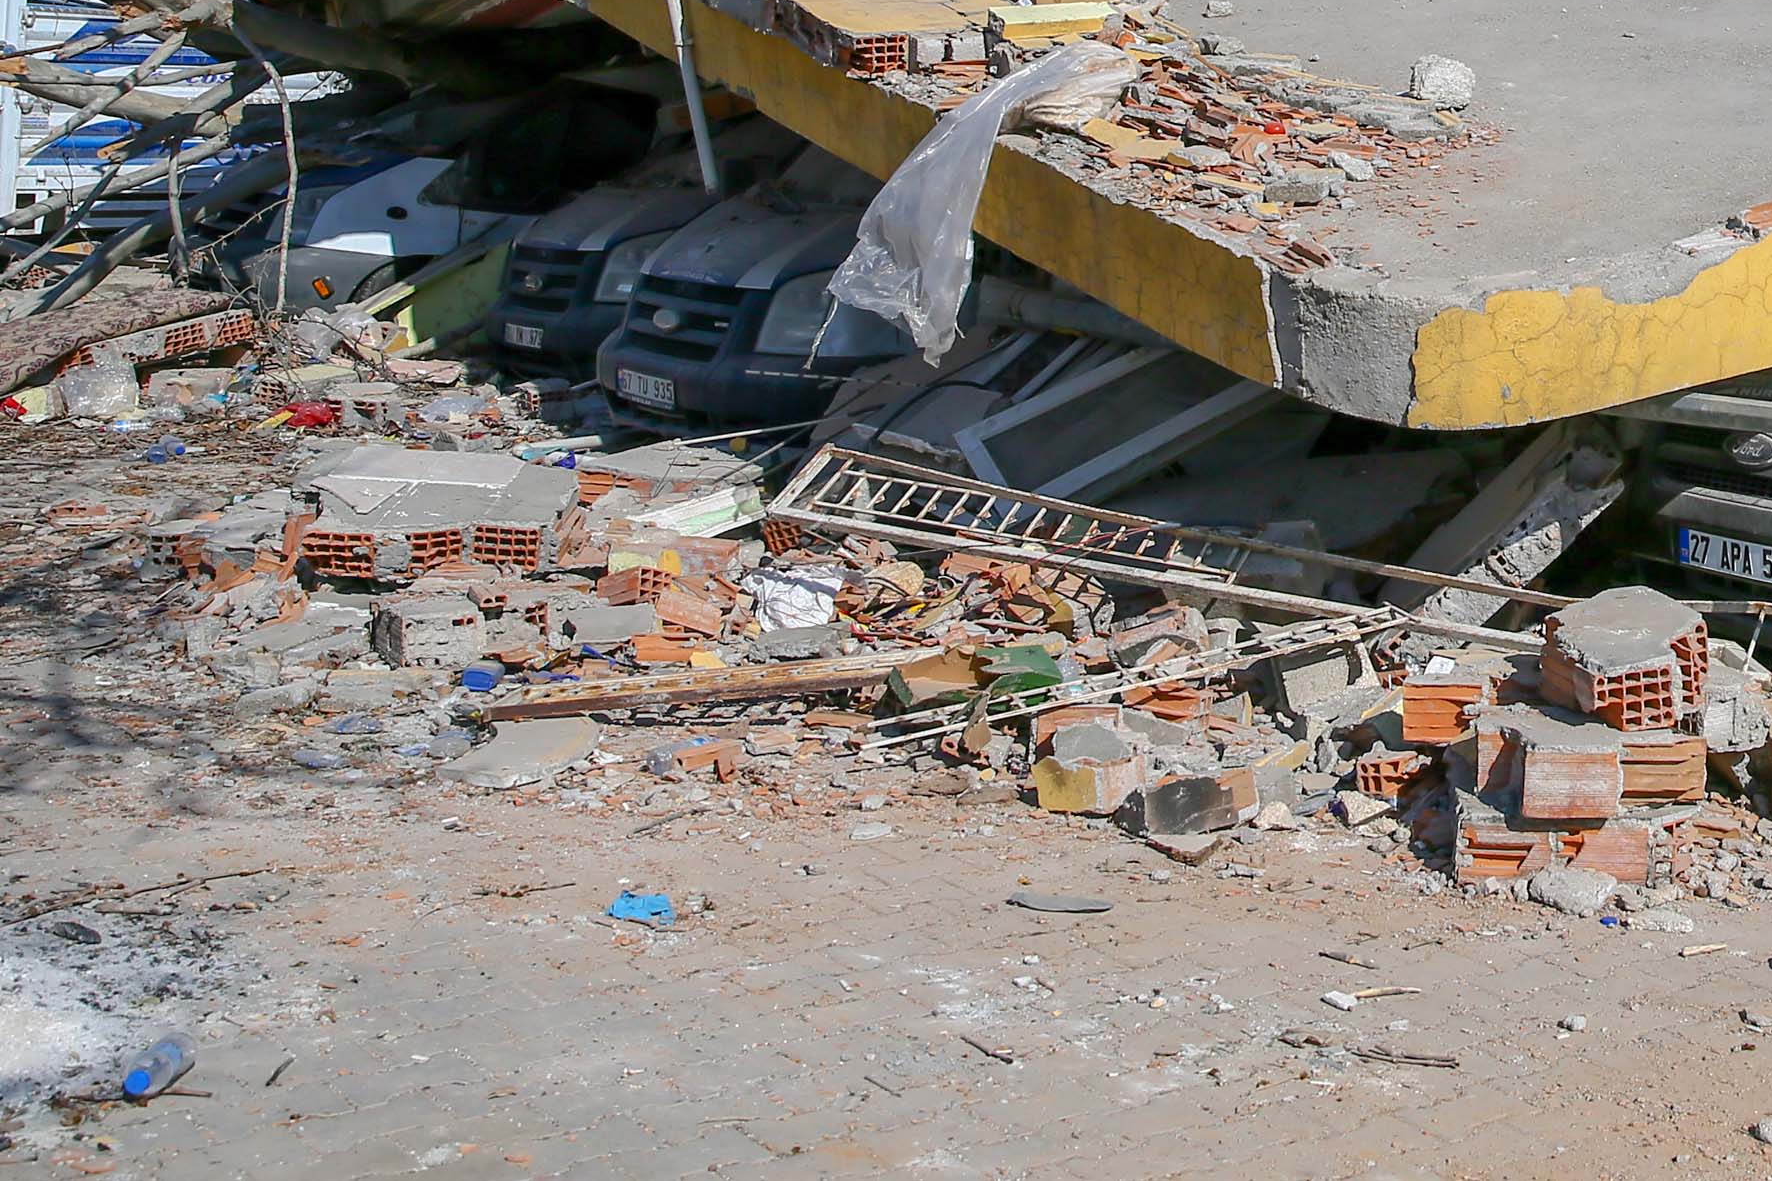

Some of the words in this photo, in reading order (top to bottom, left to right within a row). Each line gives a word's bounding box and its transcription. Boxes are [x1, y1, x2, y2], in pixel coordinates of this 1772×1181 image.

[655, 379, 673, 401] 935
[1732, 439, 1763, 458] Ford
[1690, 534, 1711, 565] 27
[1721, 541, 1753, 576] APA
